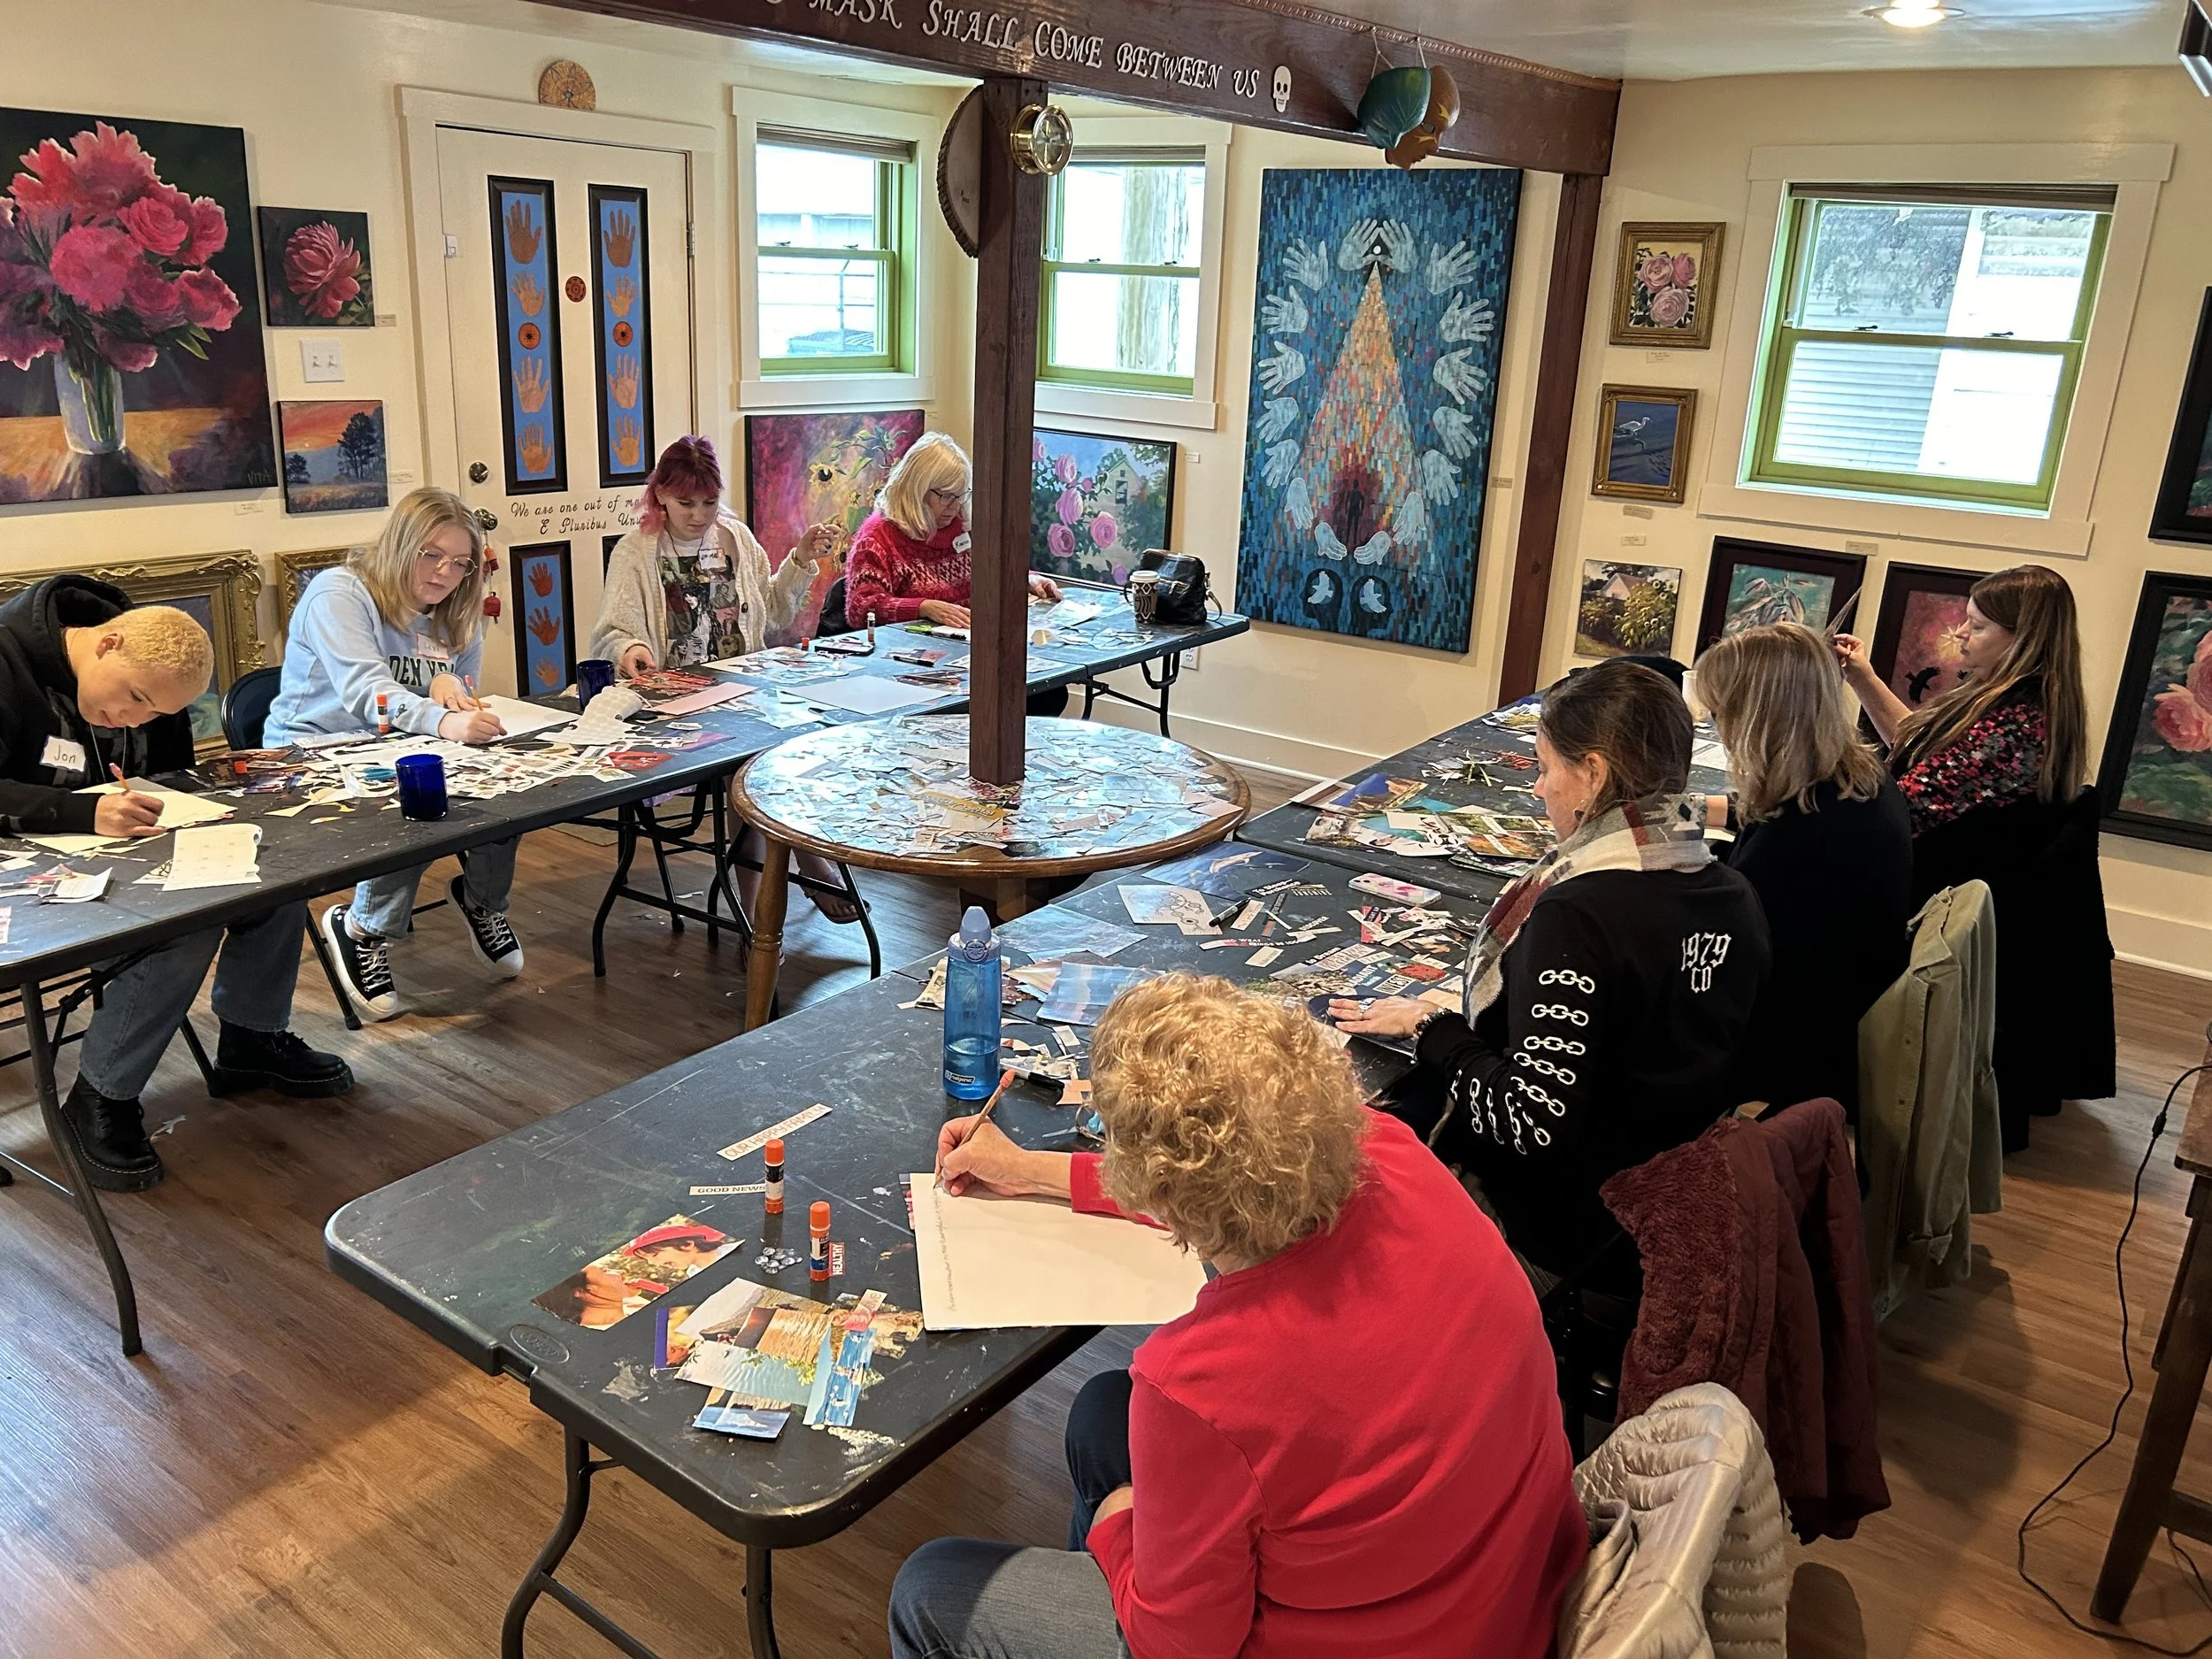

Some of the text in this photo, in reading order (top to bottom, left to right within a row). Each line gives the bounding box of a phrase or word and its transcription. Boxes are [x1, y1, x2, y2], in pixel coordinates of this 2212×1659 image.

[922, 0, 1018, 50] SHALL
[1034, 20, 1104, 69] COME
[1117, 42, 1224, 89] BETWEEN
[1233, 68, 1260, 98] US
[511, 502, 529, 517] We
[534, 506, 554, 515] are
[559, 503, 579, 512] one
[584, 496, 602, 511] out
[607, 495, 621, 511] of
[540, 512, 641, 534] E Pluribus Unu
[53, 744, 76, 764] Jon
[1681, 932, 1732, 972] 1979
[725, 1142, 752, 1157] OUR
[749, 1126, 788, 1145] HAPPY
[832, 1243, 843, 1275] HEALTHY
